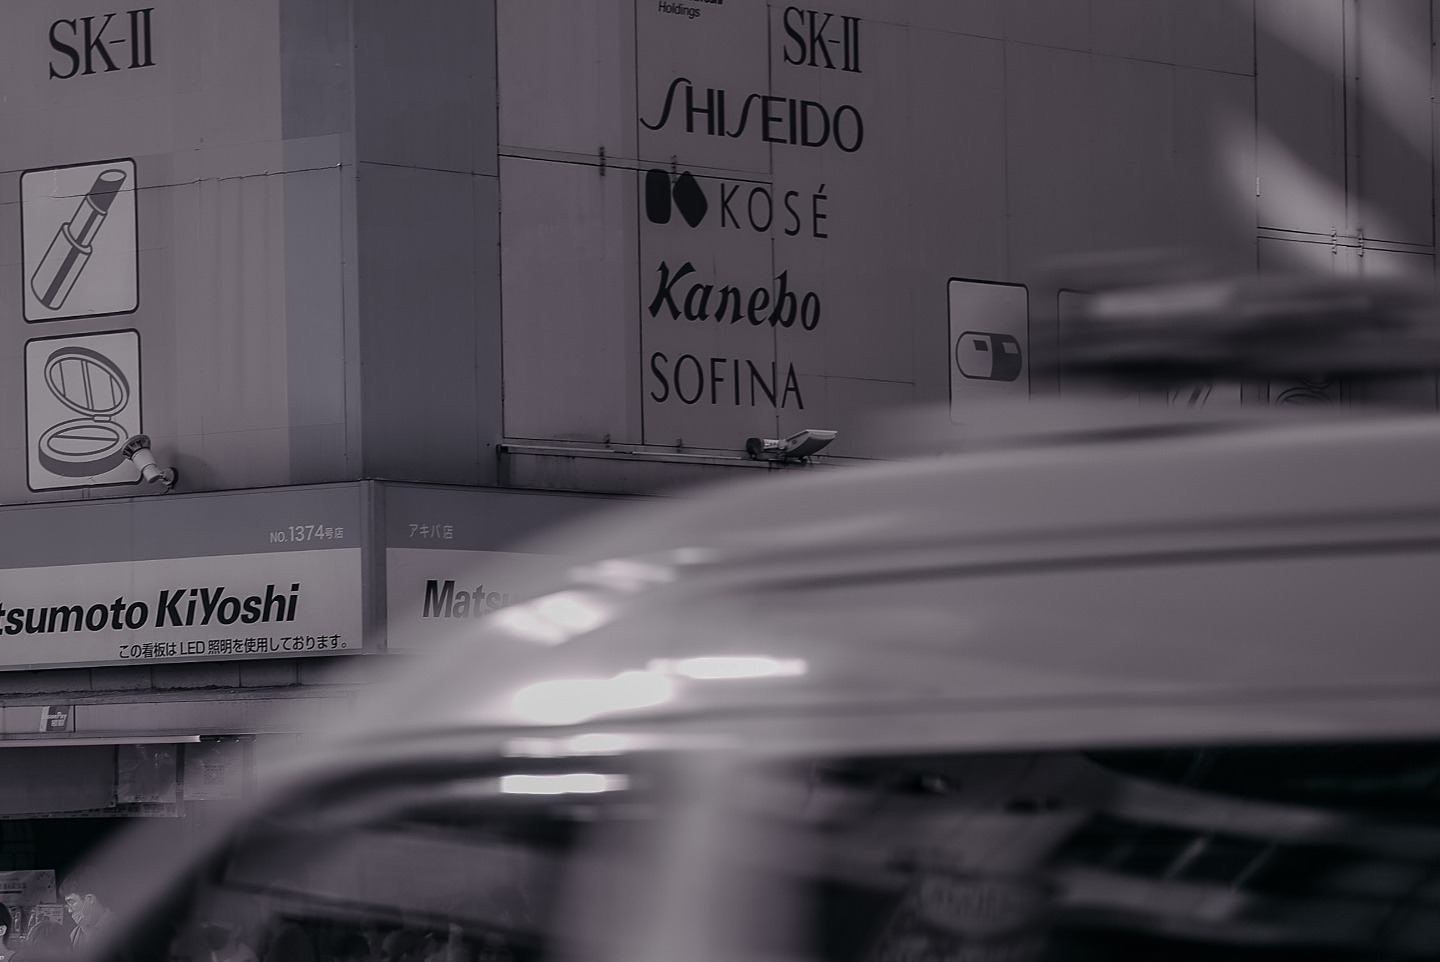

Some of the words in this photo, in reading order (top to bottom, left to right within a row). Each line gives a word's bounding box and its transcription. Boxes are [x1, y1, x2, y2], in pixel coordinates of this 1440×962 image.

[658, 1, 701, 19] Holdings
[49, 7, 156, 81] SK-II
[783, 6, 863, 73] SK-II
[640, 77, 864, 153] SHISEIDO
[720, 183, 828, 239] KOSÉ
[648, 261, 821, 331] Kanebo
[650, 352, 804, 410] SOFINA
[408, 524, 454, 540] アキバ店
[154, 583, 300, 629] KiYoshi
[119, 642, 177, 659] この看板は
[180, 640, 205, 656] LED
[208, 634, 348, 656] 照明を使用しております。
